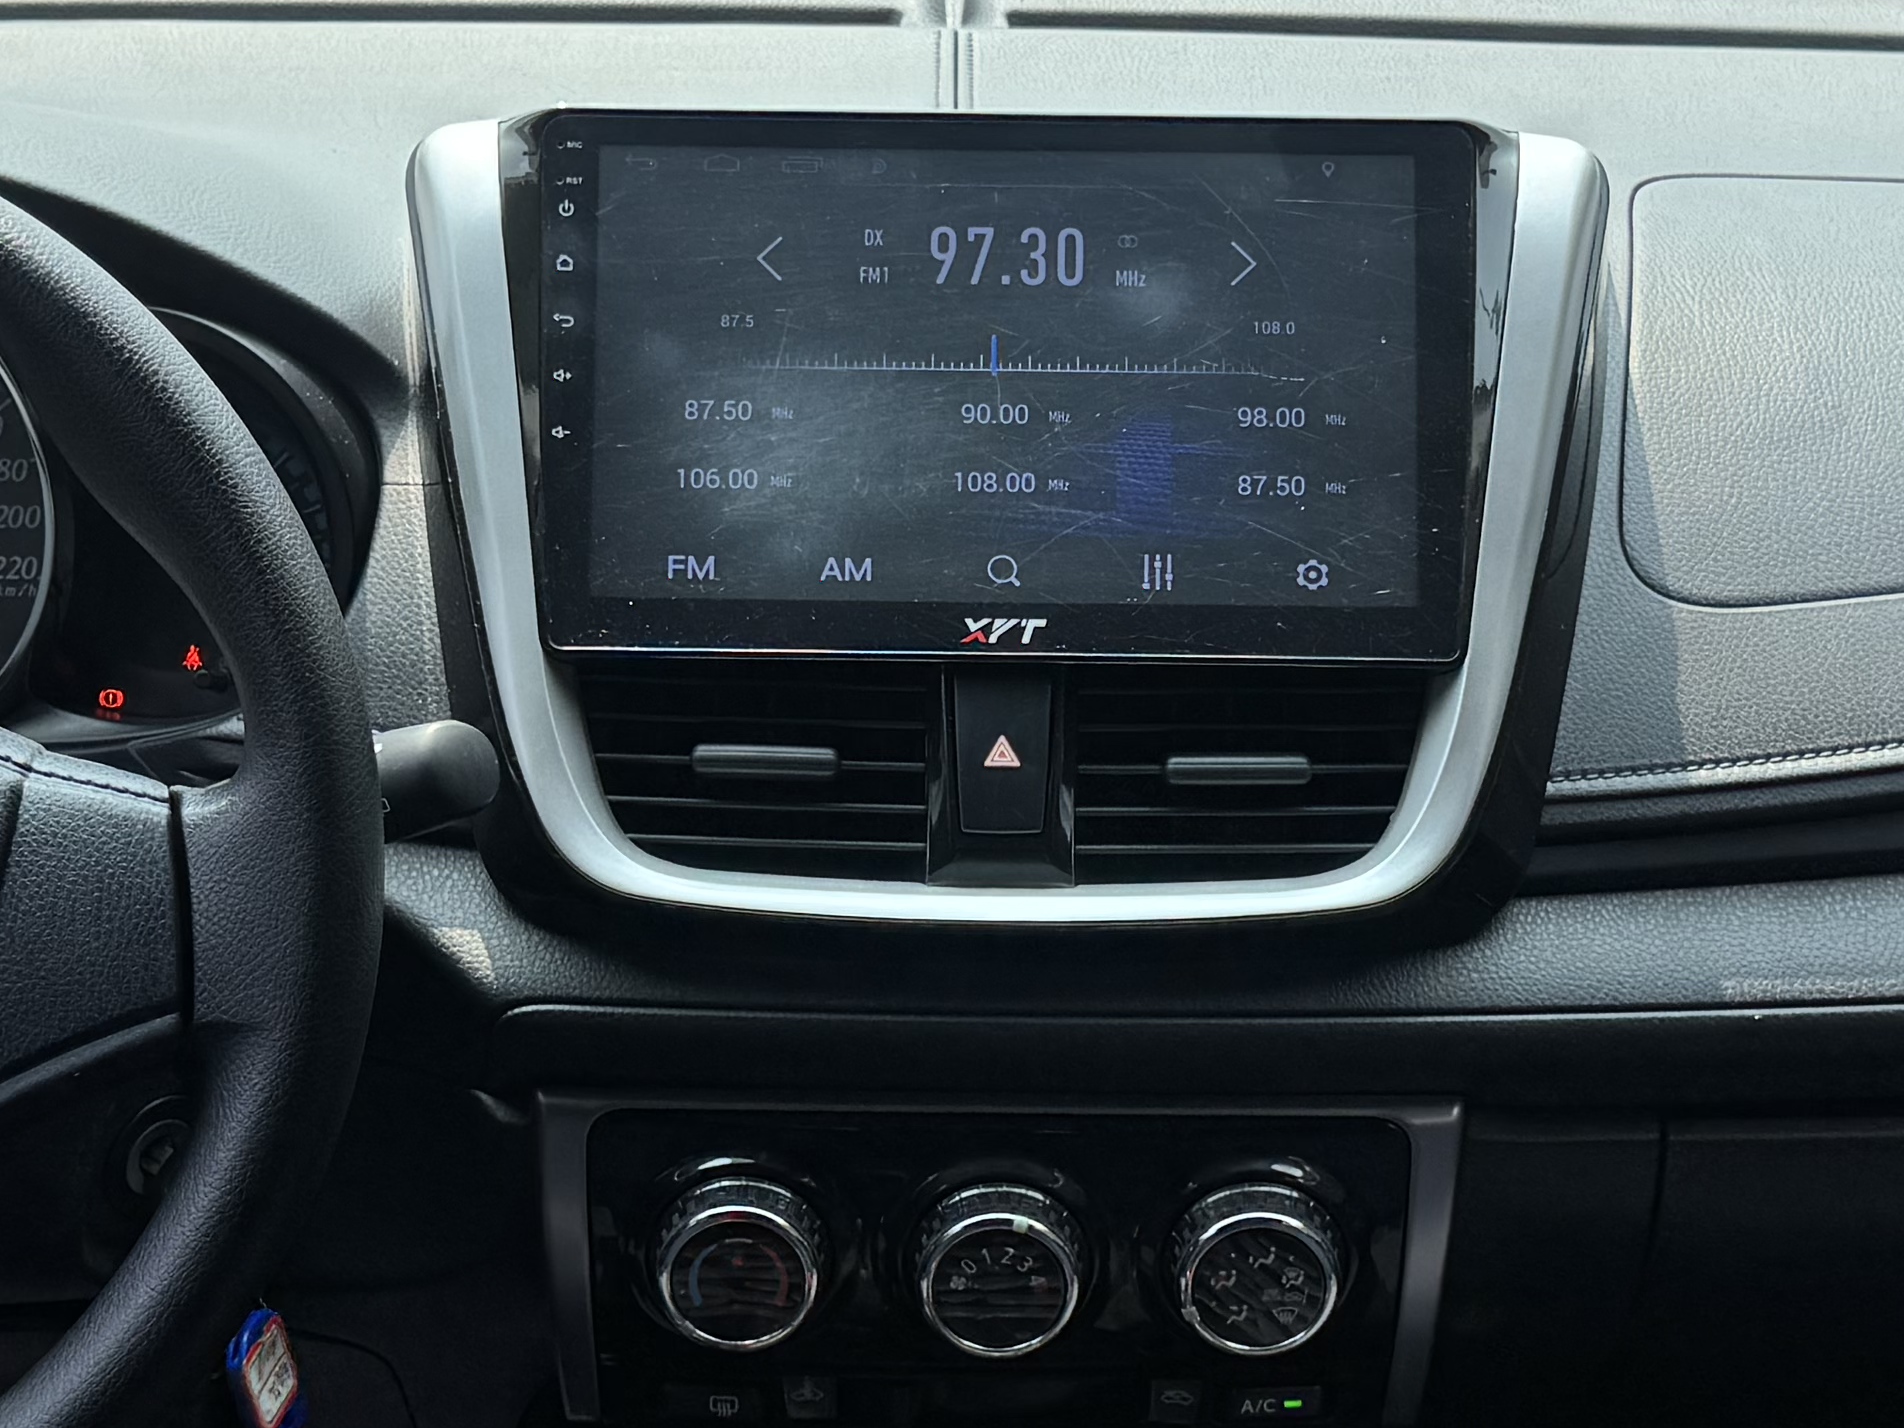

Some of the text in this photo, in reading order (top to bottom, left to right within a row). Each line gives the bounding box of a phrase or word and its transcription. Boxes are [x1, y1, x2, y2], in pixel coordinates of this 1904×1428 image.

[864, 229, 884, 247] DX
[930, 225, 1147, 288] 97.30 MHz
[859, 266, 889, 284] FM1
[720, 313, 755, 330] 87.5
[1252, 320, 1296, 336] 108.0
[683, 399, 754, 422] 87.50
[960, 402, 1072, 426] 90.00 MHz
[1236, 406, 1347, 430] 98.00 MHz
[675, 467, 793, 491] 106.00 MHz
[952, 470, 1071, 495] 108.00 MHz
[1236, 474, 1347, 498] 87.50 MHz
[667, 556, 716, 582] FM
[819, 556, 874, 583] AM
[961, 1258, 978, 1275] 0
[980, 1247, 991, 1266] 1
[1000, 1246, 1017, 1266] 2
[1017, 1256, 1033, 1274] 3
[1240, 1397, 1278, 1415] A/C
